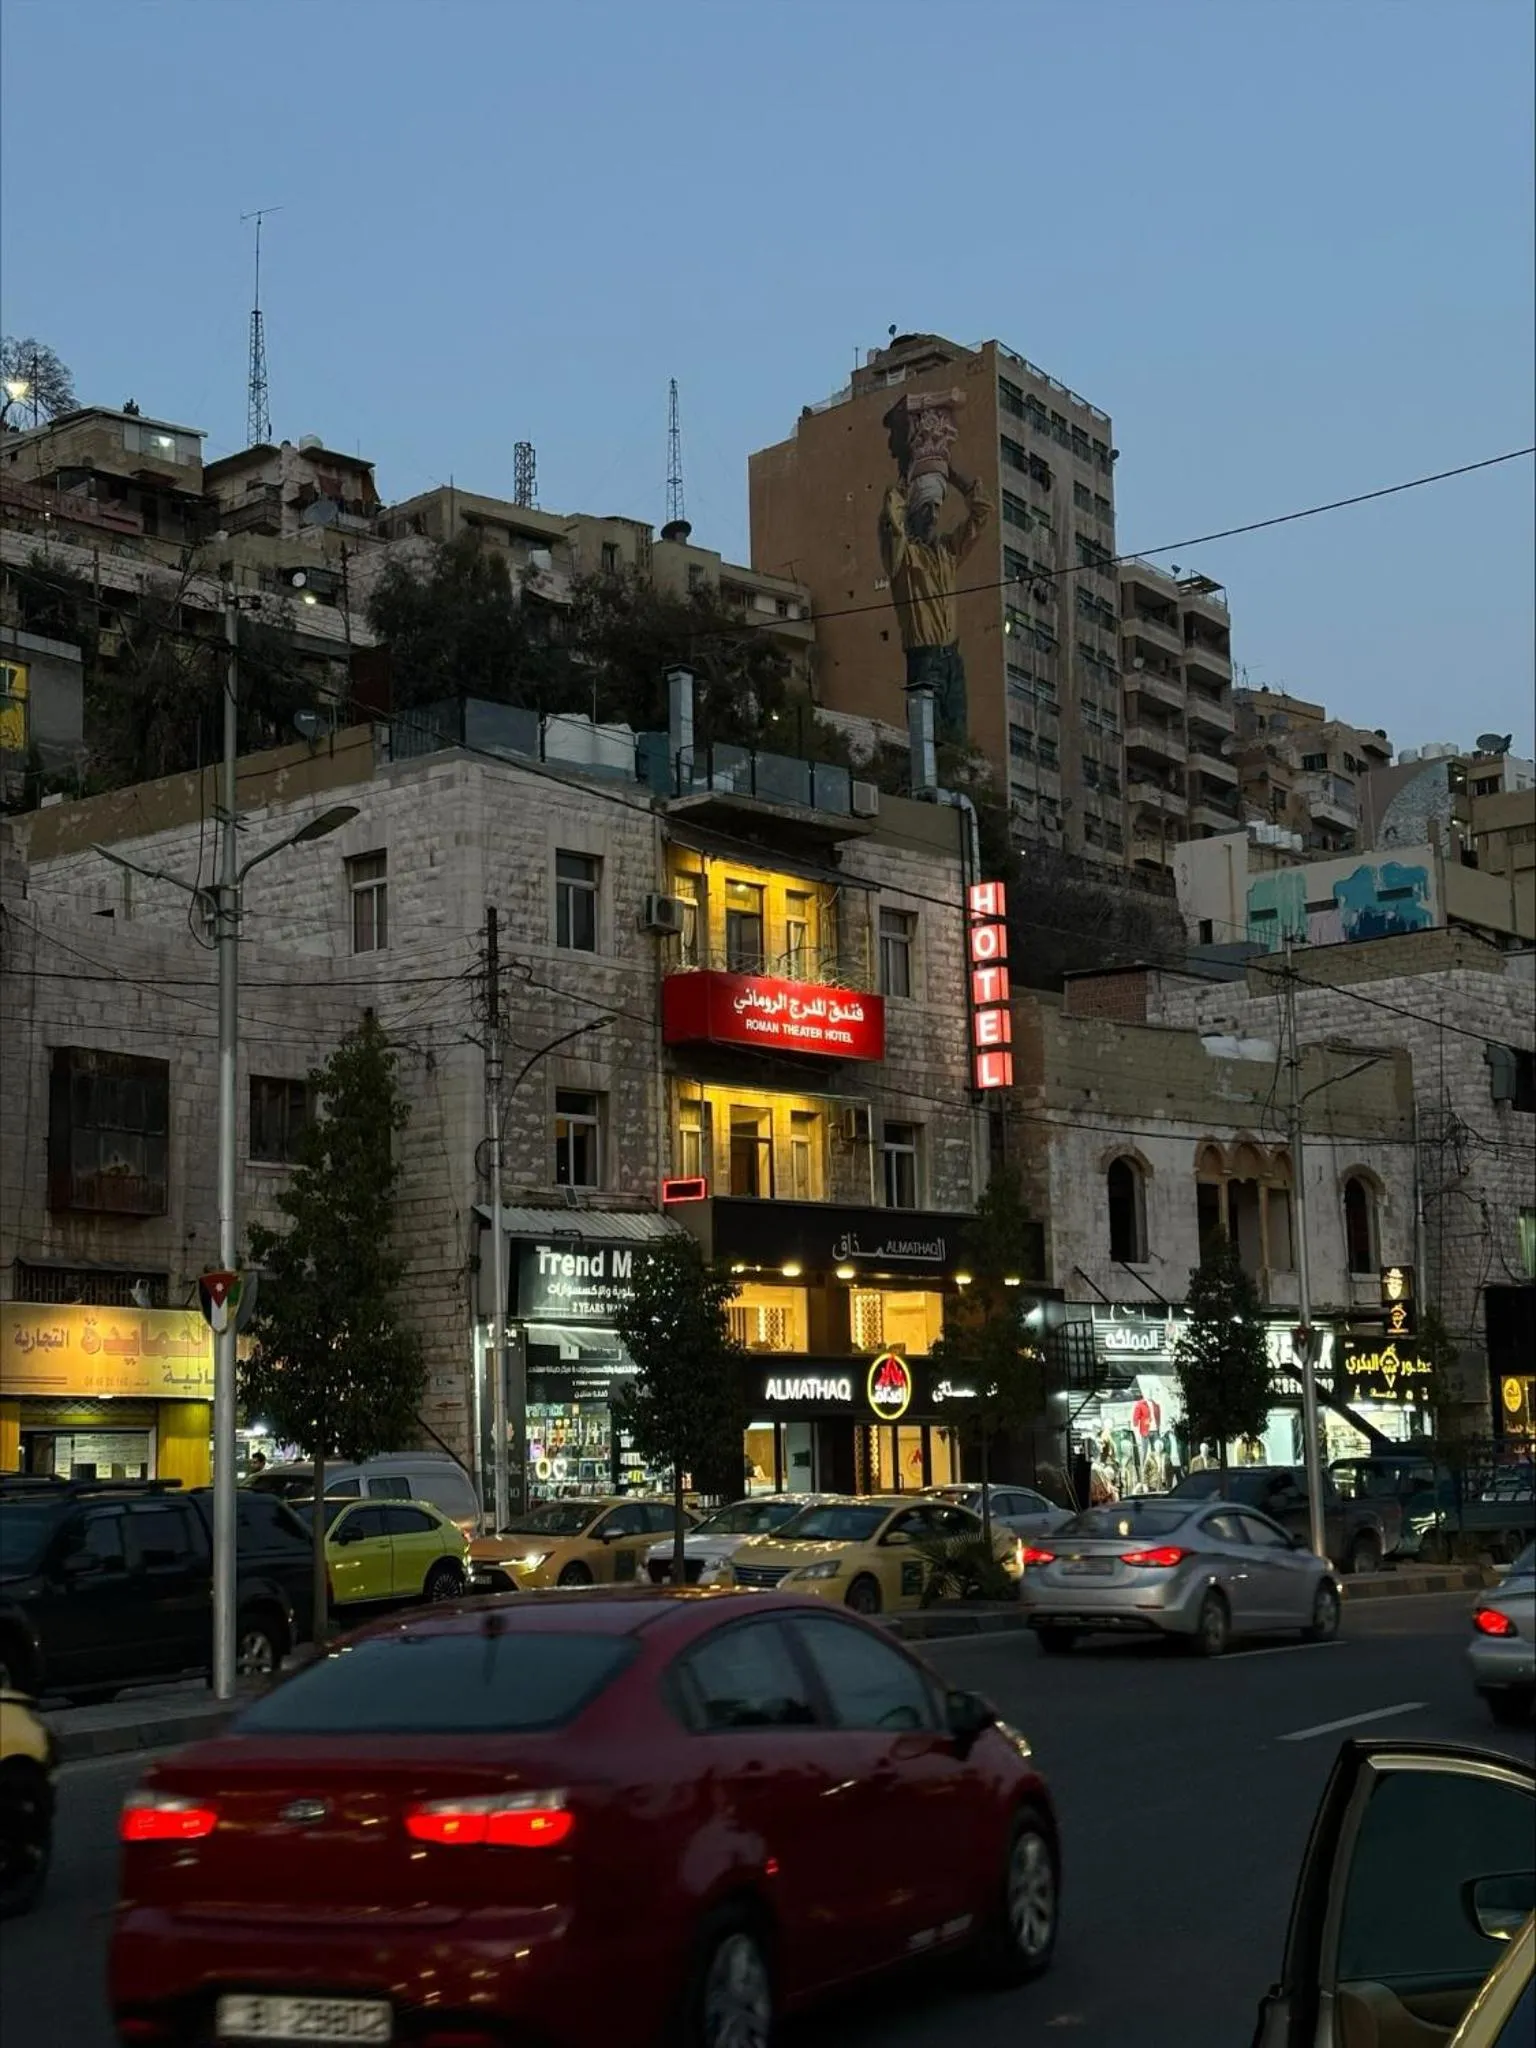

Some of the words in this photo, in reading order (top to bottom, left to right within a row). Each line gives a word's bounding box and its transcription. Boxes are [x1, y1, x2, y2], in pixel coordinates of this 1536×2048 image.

[972, 884, 1000, 1087] HOTEL
[733, 987, 787, 1014] الروماني
[789, 998, 827, 1019] المدرج
[828, 1001, 865, 1023] فندق
[745, 1018, 780, 1034] ROMAN
[781, 1023, 823, 1039] THEATER
[824, 1028, 853, 1044] HOTEL
[885, 1240, 939, 1256] ALMATHAQ
[535, 1245, 605, 1278] Trend
[579, 1301, 606, 1314] YEARS
[13, 1322, 70, 1353] التجارية
[1345, 1353, 1380, 1375] البكري
[765, 1378, 852, 1401] ALMATHAQ
